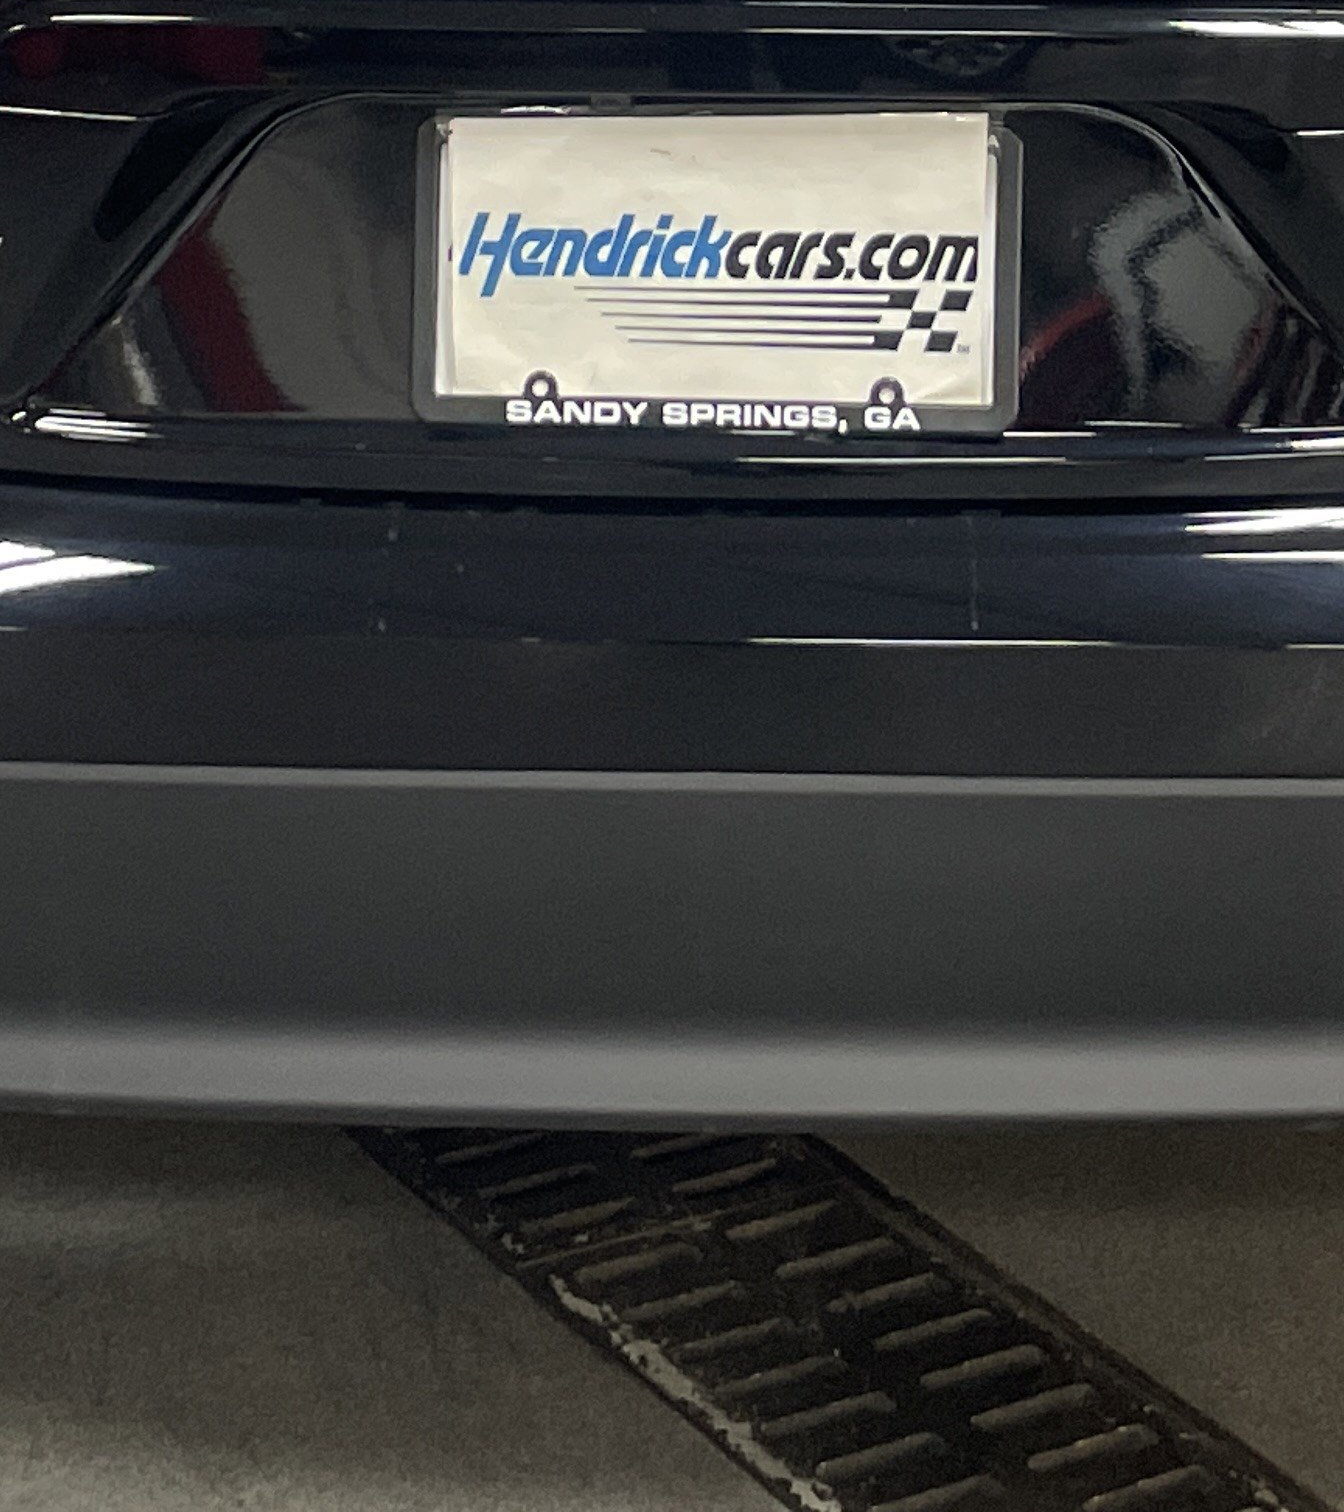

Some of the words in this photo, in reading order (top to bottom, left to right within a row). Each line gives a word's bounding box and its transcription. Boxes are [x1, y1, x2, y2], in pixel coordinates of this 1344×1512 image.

[458, 211, 979, 298] Hendrickcars.com
[505, 399, 649, 427] SANDY
[662, 401, 848, 433] SPRINGS,
[863, 407, 921, 431] GA
